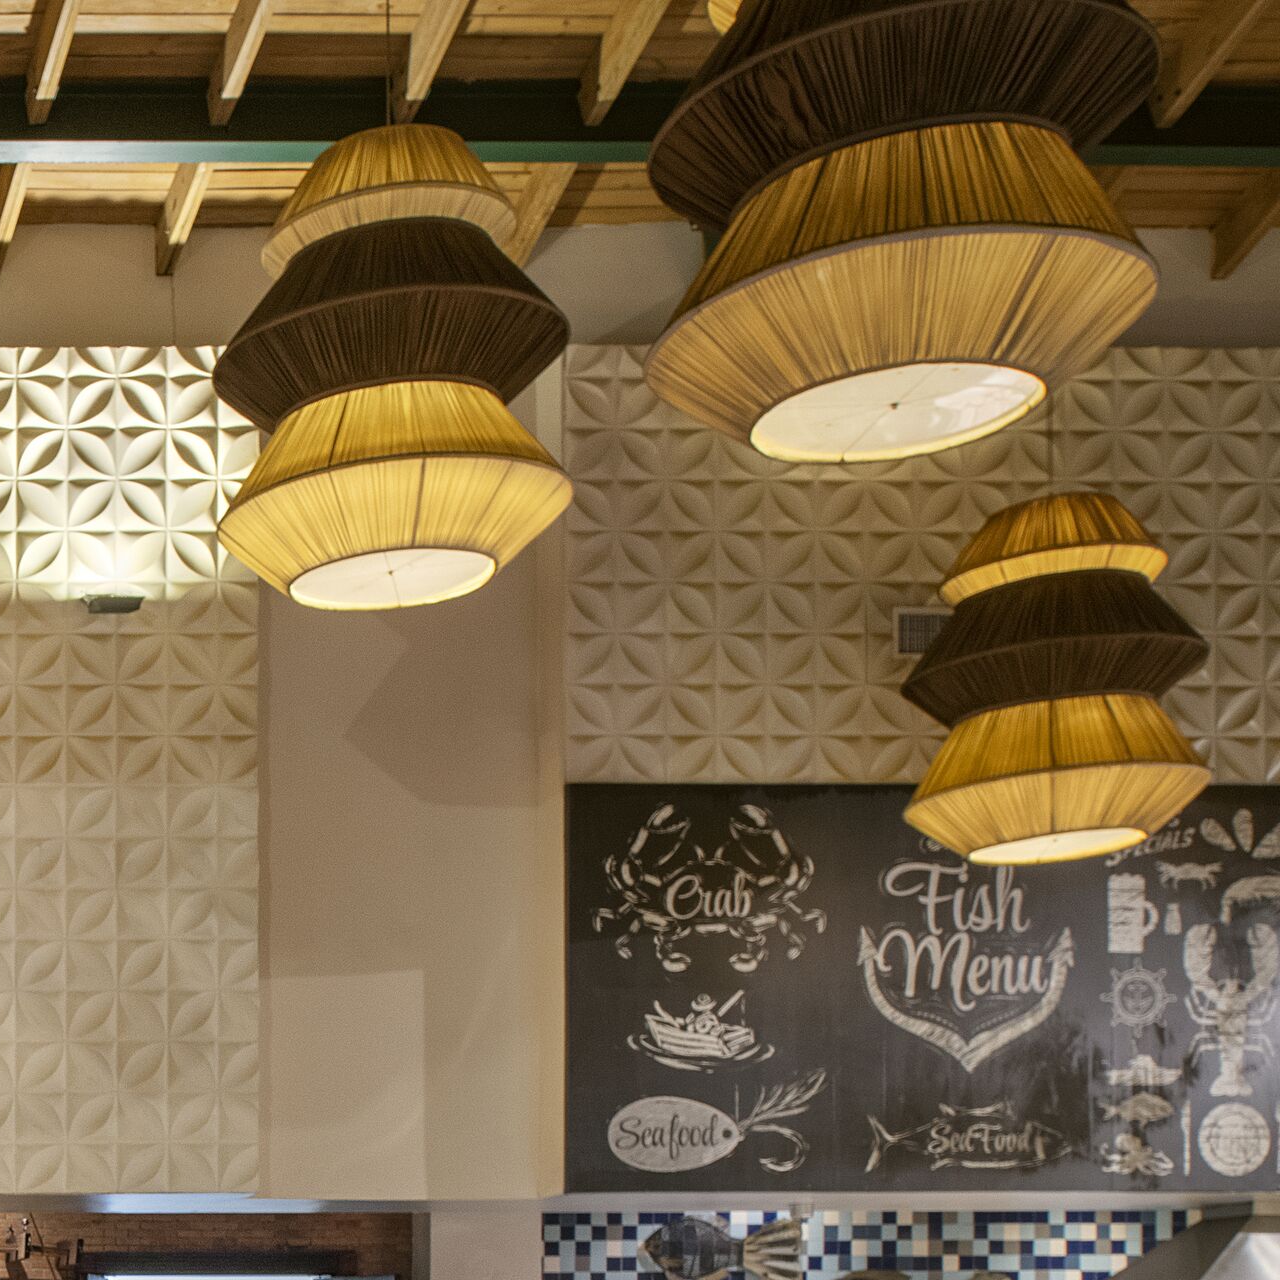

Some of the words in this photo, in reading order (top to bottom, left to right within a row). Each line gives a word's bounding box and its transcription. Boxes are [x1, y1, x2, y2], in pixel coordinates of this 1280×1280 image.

[666, 872, 753, 919] Crab
[885, 861, 1031, 934] Fish
[877, 929, 1049, 1012] Menu
[615, 1113, 718, 1160] Seafood
